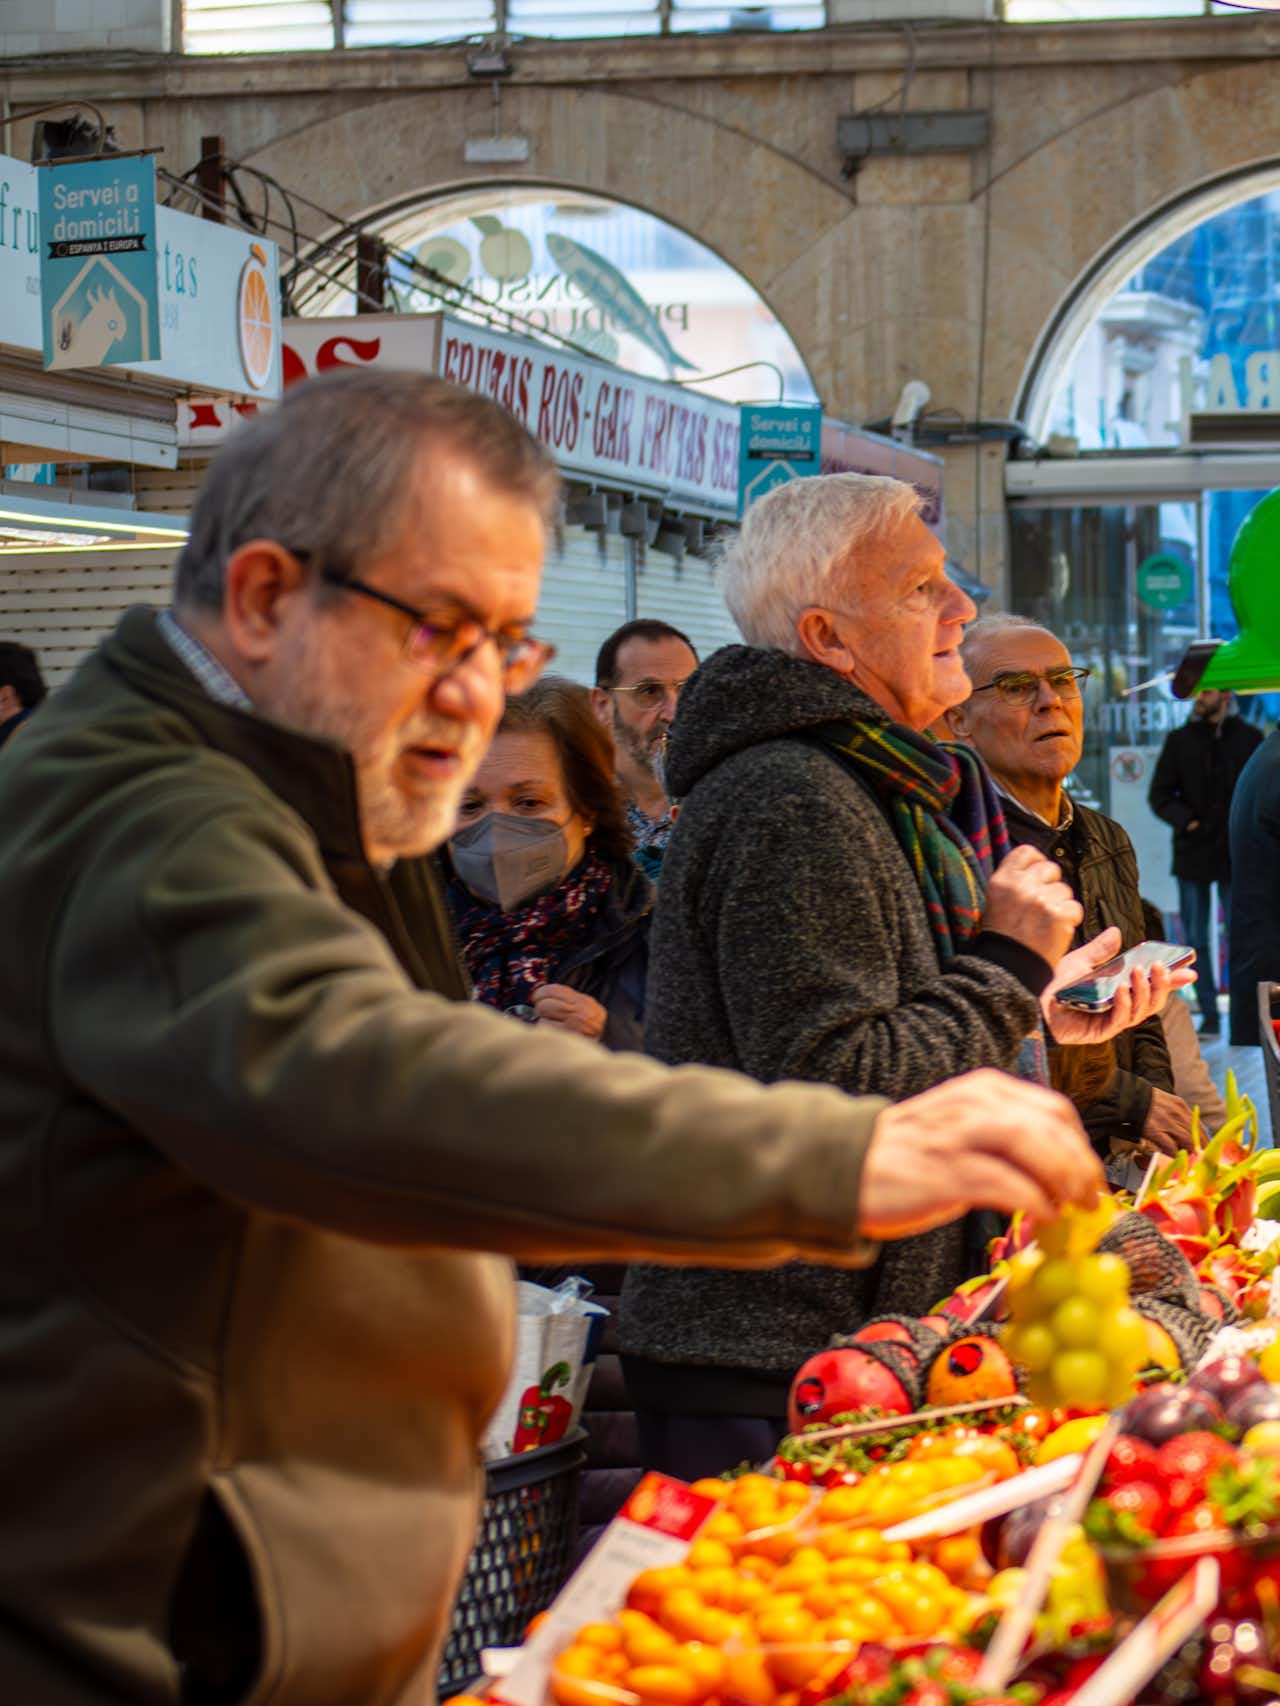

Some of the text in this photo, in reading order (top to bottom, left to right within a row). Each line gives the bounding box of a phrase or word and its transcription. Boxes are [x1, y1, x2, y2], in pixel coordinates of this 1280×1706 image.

[53, 179, 139, 210] Servei a
[53, 208, 140, 240] domicili
[109, 239, 139, 251] EUROPA
[751, 415, 812, 432] Servei a
[638, 395, 708, 486] FRUTAS
[750, 434, 811, 449] domicili
